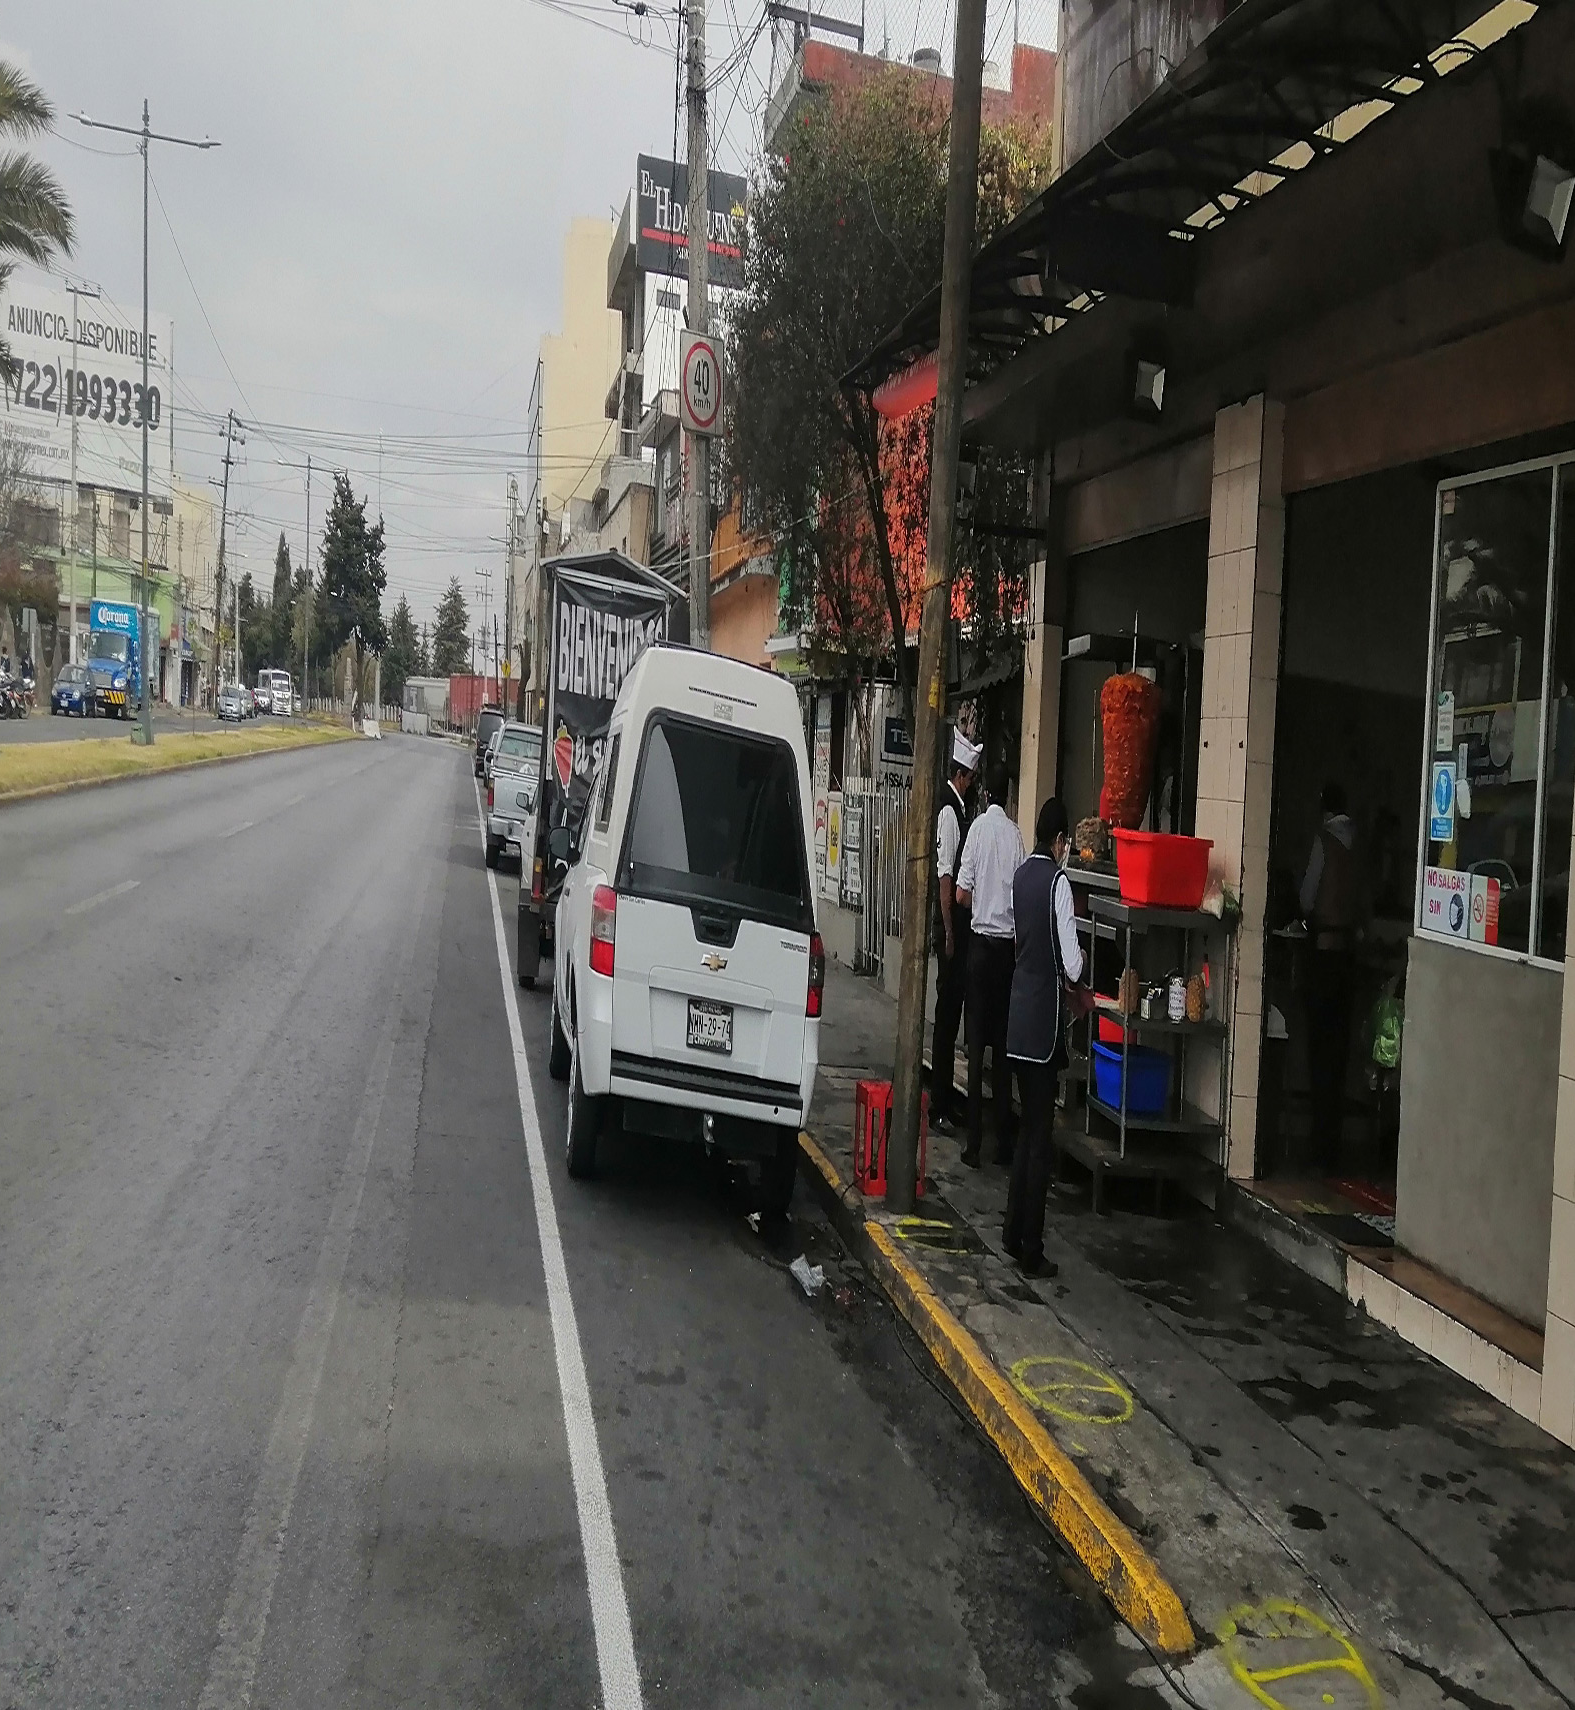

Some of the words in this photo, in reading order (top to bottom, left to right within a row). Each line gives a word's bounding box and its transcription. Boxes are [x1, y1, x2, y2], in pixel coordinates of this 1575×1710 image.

[641, 169, 656, 198] EL
[8, 304, 66, 342] ANUNCIO
[76, 319, 157, 361] DISPONIBLE
[694, 359, 710, 396] 40
[693, 396, 711, 410] km/h
[98, 606, 129, 625] Corona
[1428, 870, 1437, 887] NO
[1438, 873, 1466, 891] SALGAS
[1429, 898, 1441, 915] SIN
